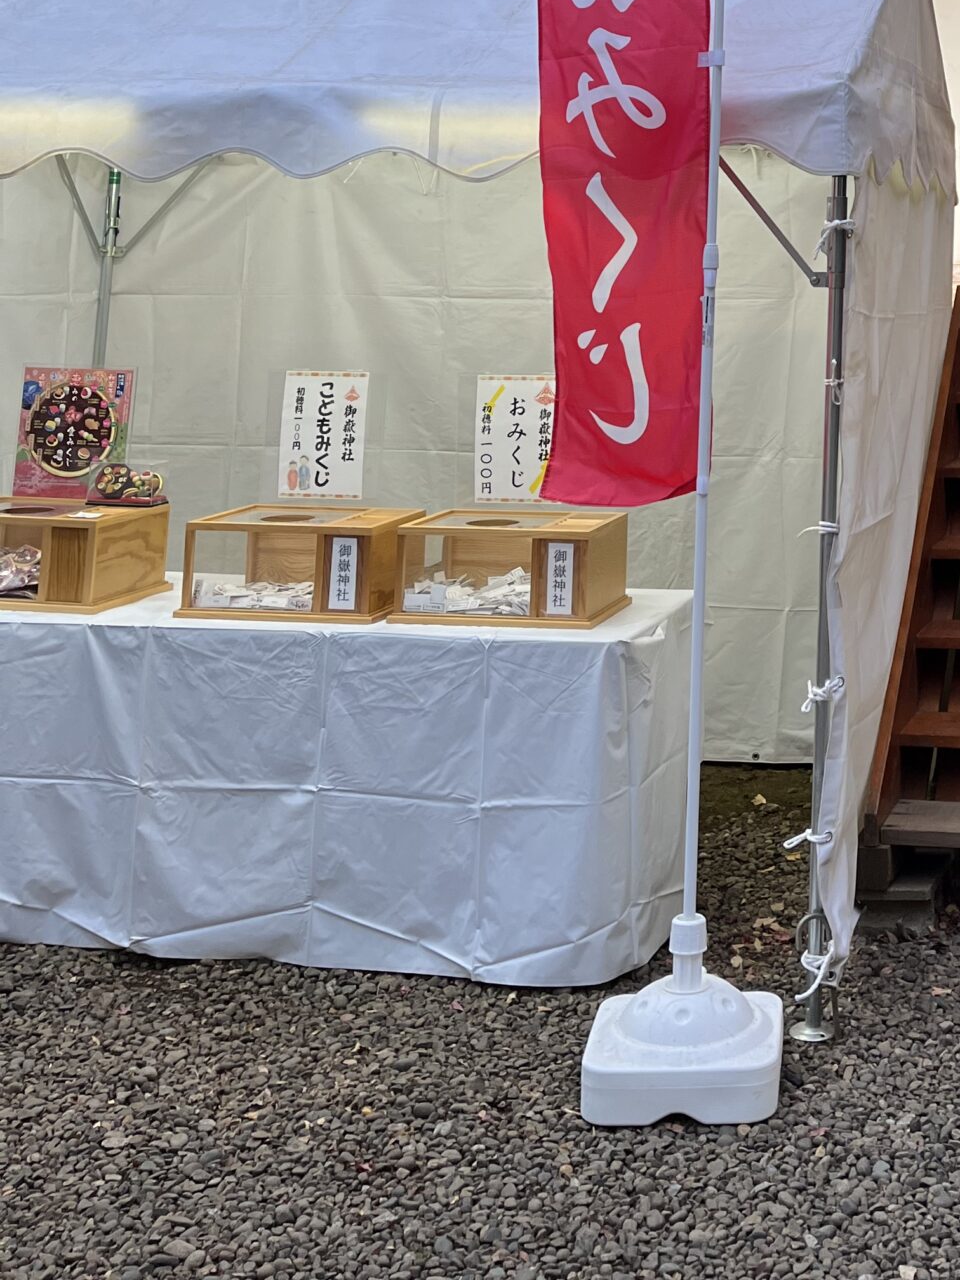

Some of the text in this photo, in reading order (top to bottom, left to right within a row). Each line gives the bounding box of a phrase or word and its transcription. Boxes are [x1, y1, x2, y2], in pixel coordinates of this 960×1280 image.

[314, 381, 335, 488] こどもみくじ
[506, 396, 527, 488] おみくじ
[335, 543, 352, 602] 御嶽神社
[552, 549, 567, 608] 御嶽神社
